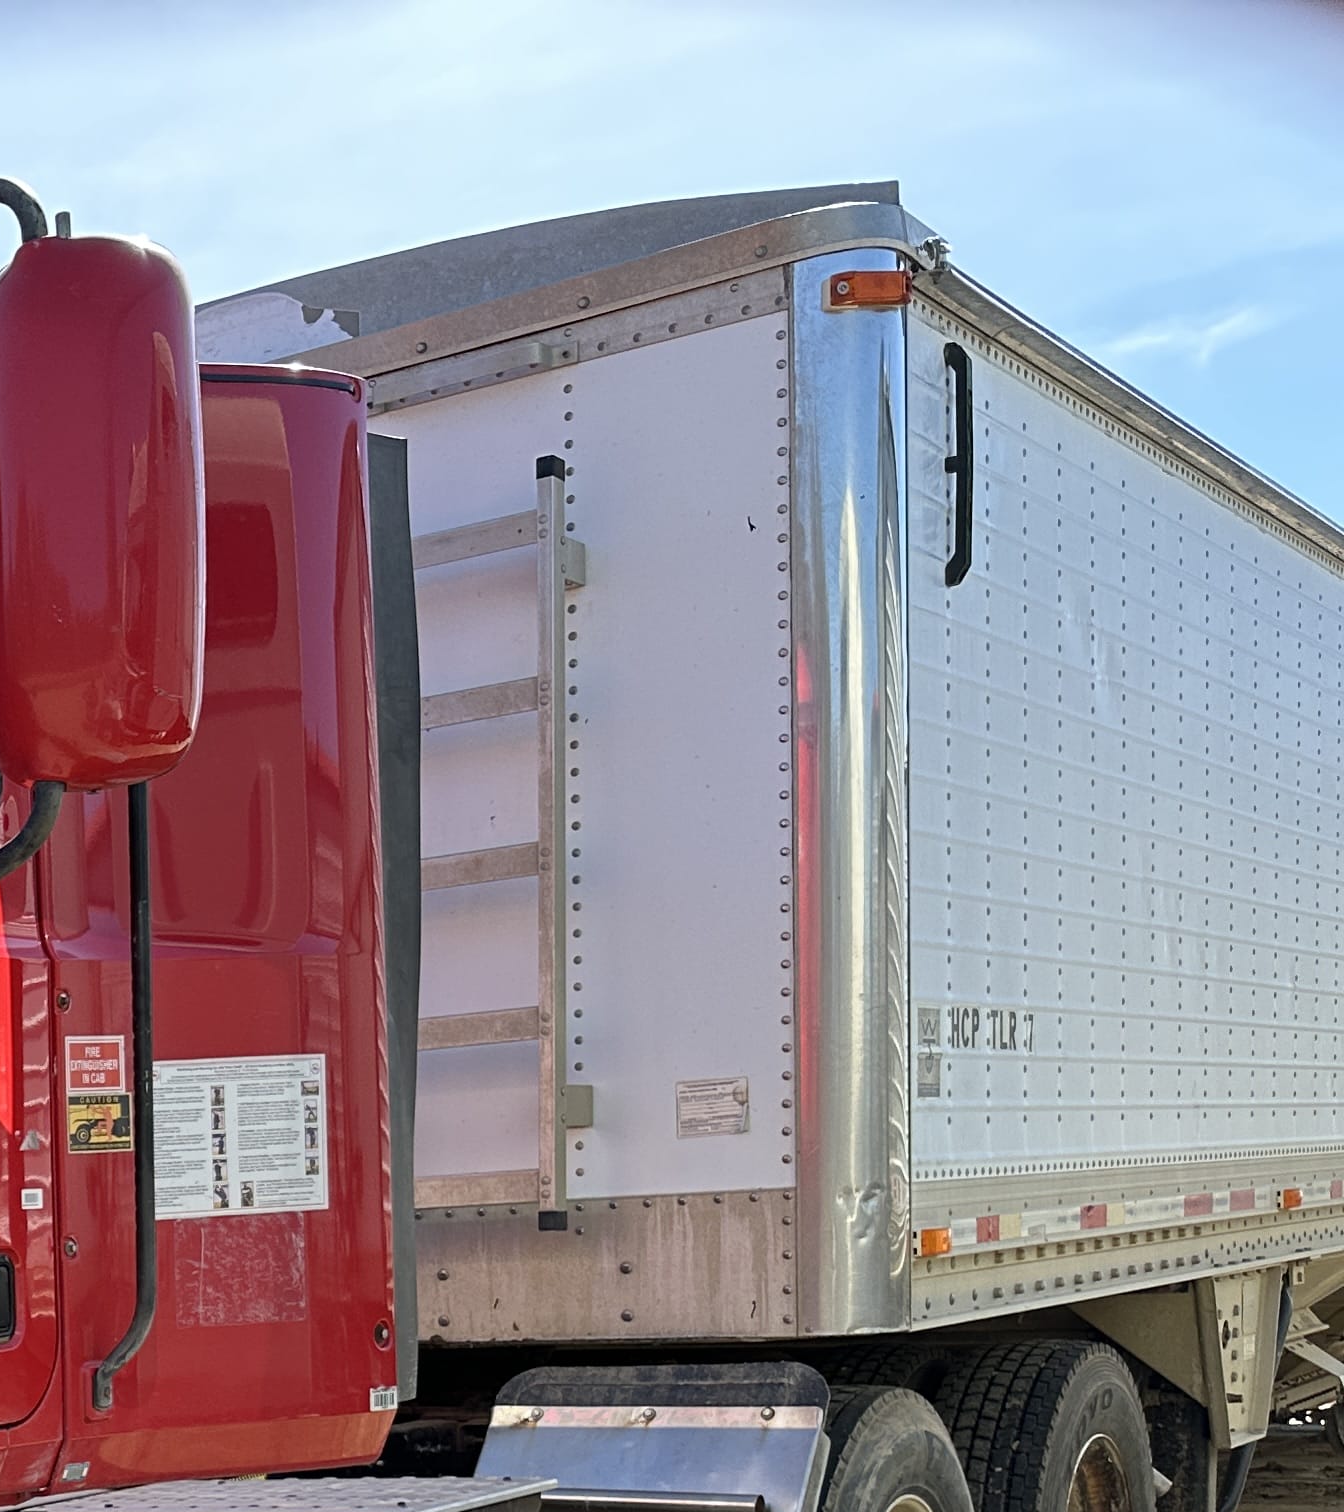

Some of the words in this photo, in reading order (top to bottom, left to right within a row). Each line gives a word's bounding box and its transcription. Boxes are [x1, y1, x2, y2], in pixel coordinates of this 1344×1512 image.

[952, 1007, 980, 1049] HCP
[991, 1009, 1017, 1051] TLR
[84, 1046, 101, 1058] FIRE
[91, 1072, 106, 1084] CAB
[79, 1095, 119, 1104] CAUTION
